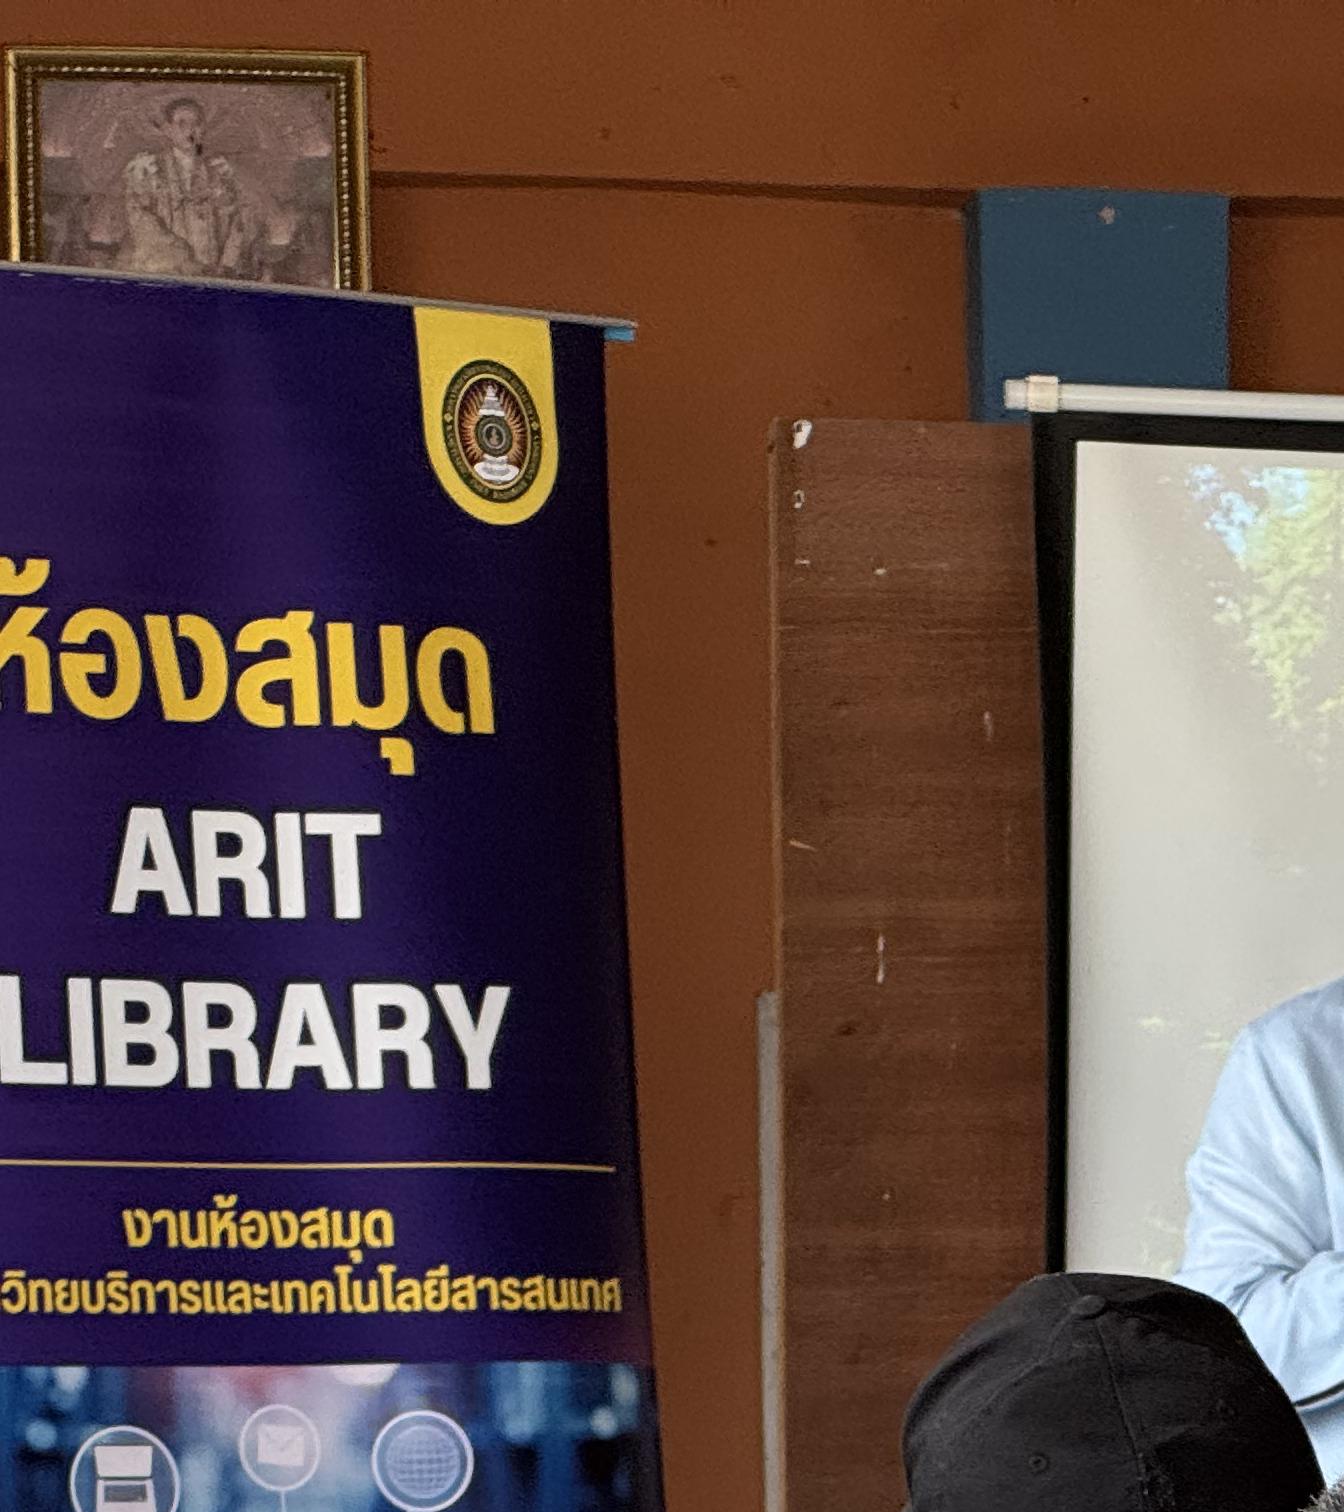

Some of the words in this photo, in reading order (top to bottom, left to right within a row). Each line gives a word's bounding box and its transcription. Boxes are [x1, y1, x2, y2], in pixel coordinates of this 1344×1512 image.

[111, 807, 381, 919] ARIT
[0, 975, 511, 1090] LIBRARY
[122, 1194, 395, 1262] งานห้องสมุด
[1, 1264, 622, 1314] วิทยบริการและเทคโนโลยีสารสนเทศ
